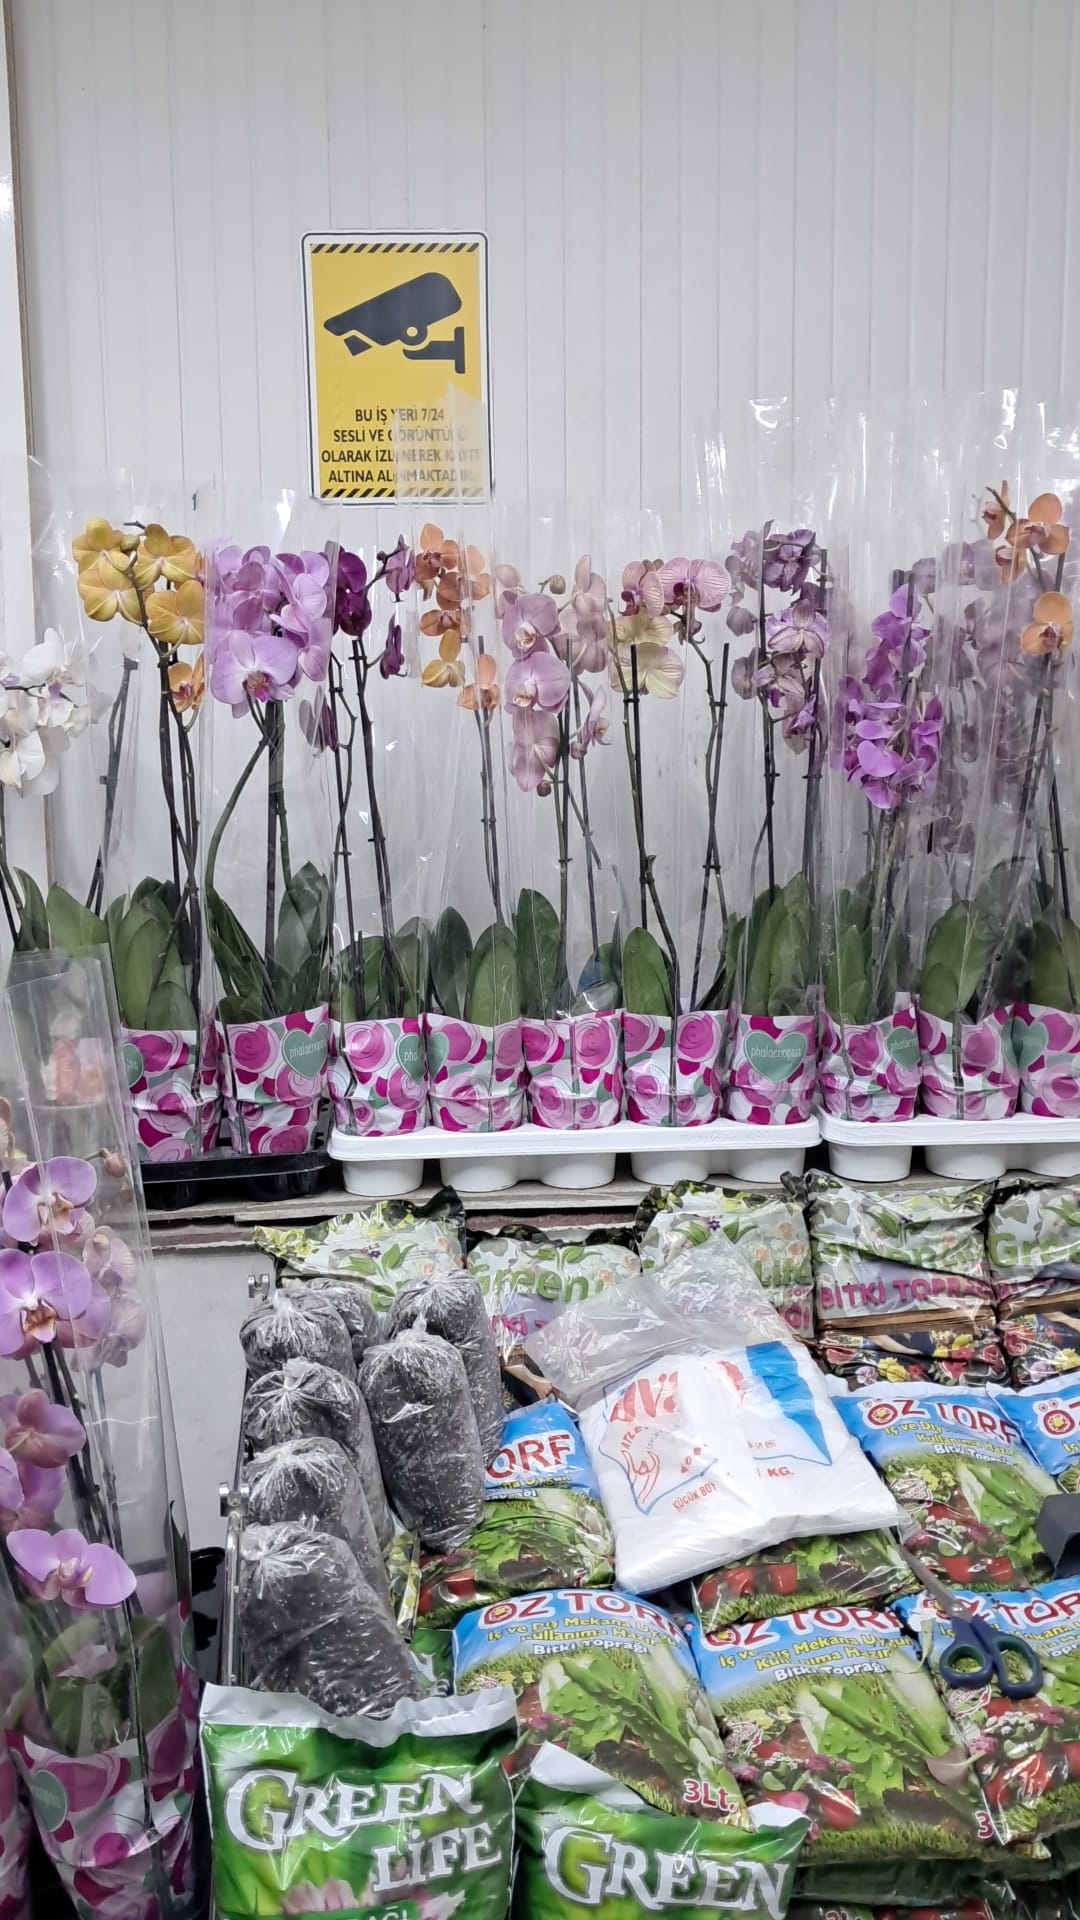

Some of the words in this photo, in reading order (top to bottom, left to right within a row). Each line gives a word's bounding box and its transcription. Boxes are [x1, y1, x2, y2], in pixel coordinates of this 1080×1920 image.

[355, 408, 373, 422] BU
[376, 404, 388, 425] İŞ
[421, 408, 445, 421] 7/24
[333, 425, 366, 443] SESLİ
[369, 429, 385, 442] VE
[321, 449, 372, 463] OLARAK
[328, 470, 375, 483] ALTINA
[820, 1275, 886, 1310] BİTKİ
[901, 1422, 918, 1431] ve
[936, 1402, 1018, 1445] TORF
[507, 1624, 528, 1634] ve
[563, 1616, 633, 1629] Mekana
[532, 1641, 577, 1656] Bitki
[581, 1638, 651, 1656] Toprağı
[738, 1649, 760, 1660] ve
[792, 1635, 860, 1656] Mekana
[683, 1778, 738, 1813] 3Lt.
[225, 1768, 484, 1852] GREEN
[543, 1825, 791, 1920] GREEN
